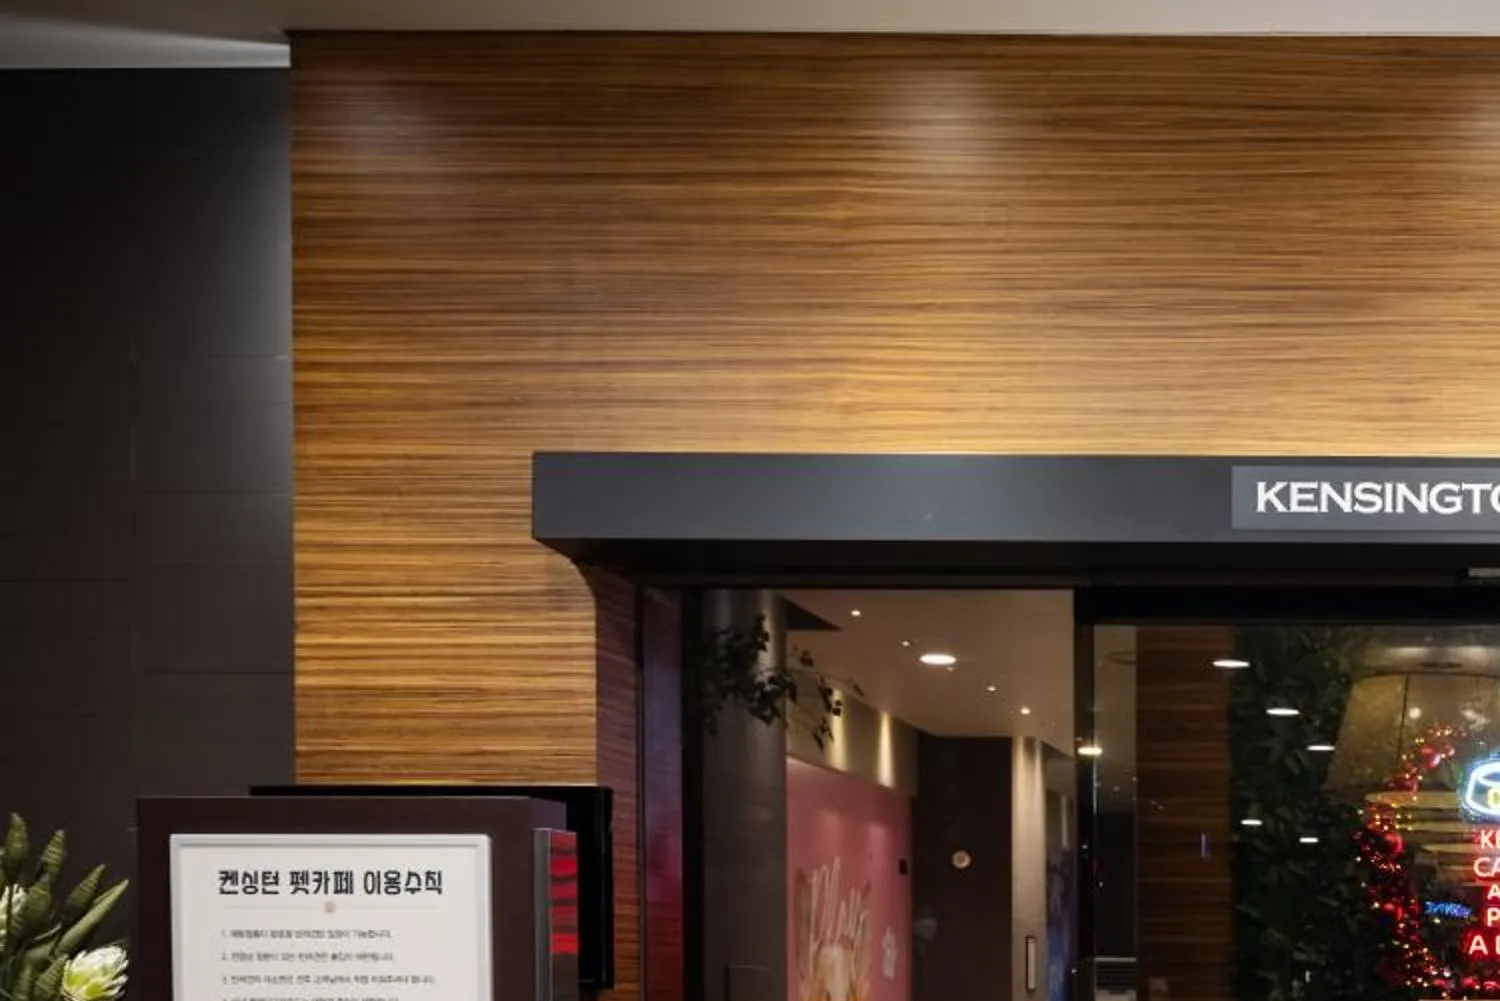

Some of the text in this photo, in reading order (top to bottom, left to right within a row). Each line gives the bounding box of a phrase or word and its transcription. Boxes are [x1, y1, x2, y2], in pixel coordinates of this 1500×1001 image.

[219, 870, 443, 895] 켄싱턴 펫카페 이용수칙
[1468, 935, 1488, 955] A
